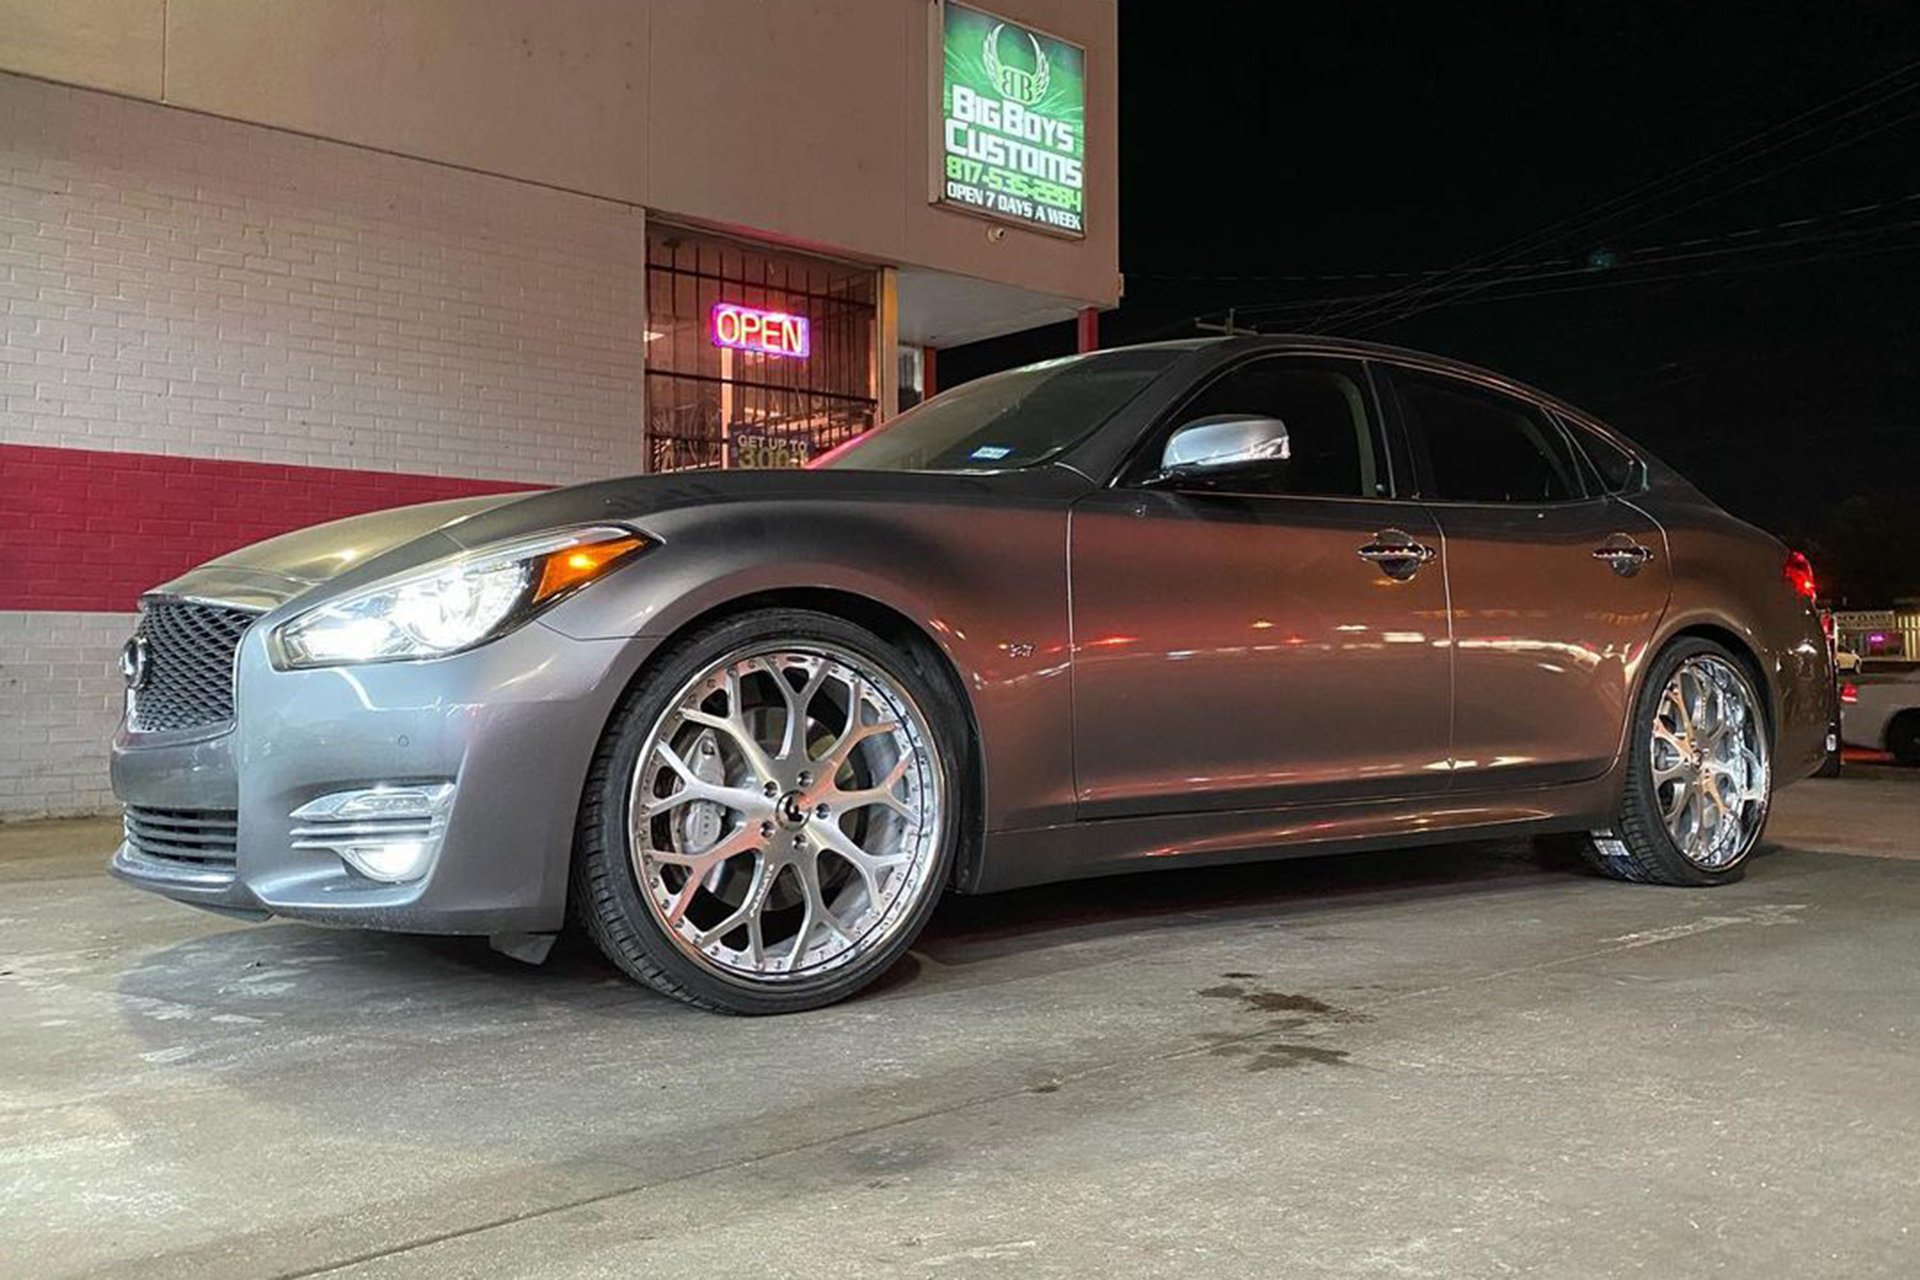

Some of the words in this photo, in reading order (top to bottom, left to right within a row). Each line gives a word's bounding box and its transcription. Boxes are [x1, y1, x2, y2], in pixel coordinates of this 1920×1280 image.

[945, 118, 1082, 188] CUSTOMS
[947, 181, 984, 207] OPEN
[985, 191, 996, 207] 7
[997, 194, 1033, 218] DAYS
[1034, 205, 1046, 221] A
[1046, 207, 1081, 230] WEEK
[716, 309, 802, 353] OPEN
[738, 434, 765, 449] GET
[768, 438, 787, 451] UP
[789, 440, 807, 453] TO
